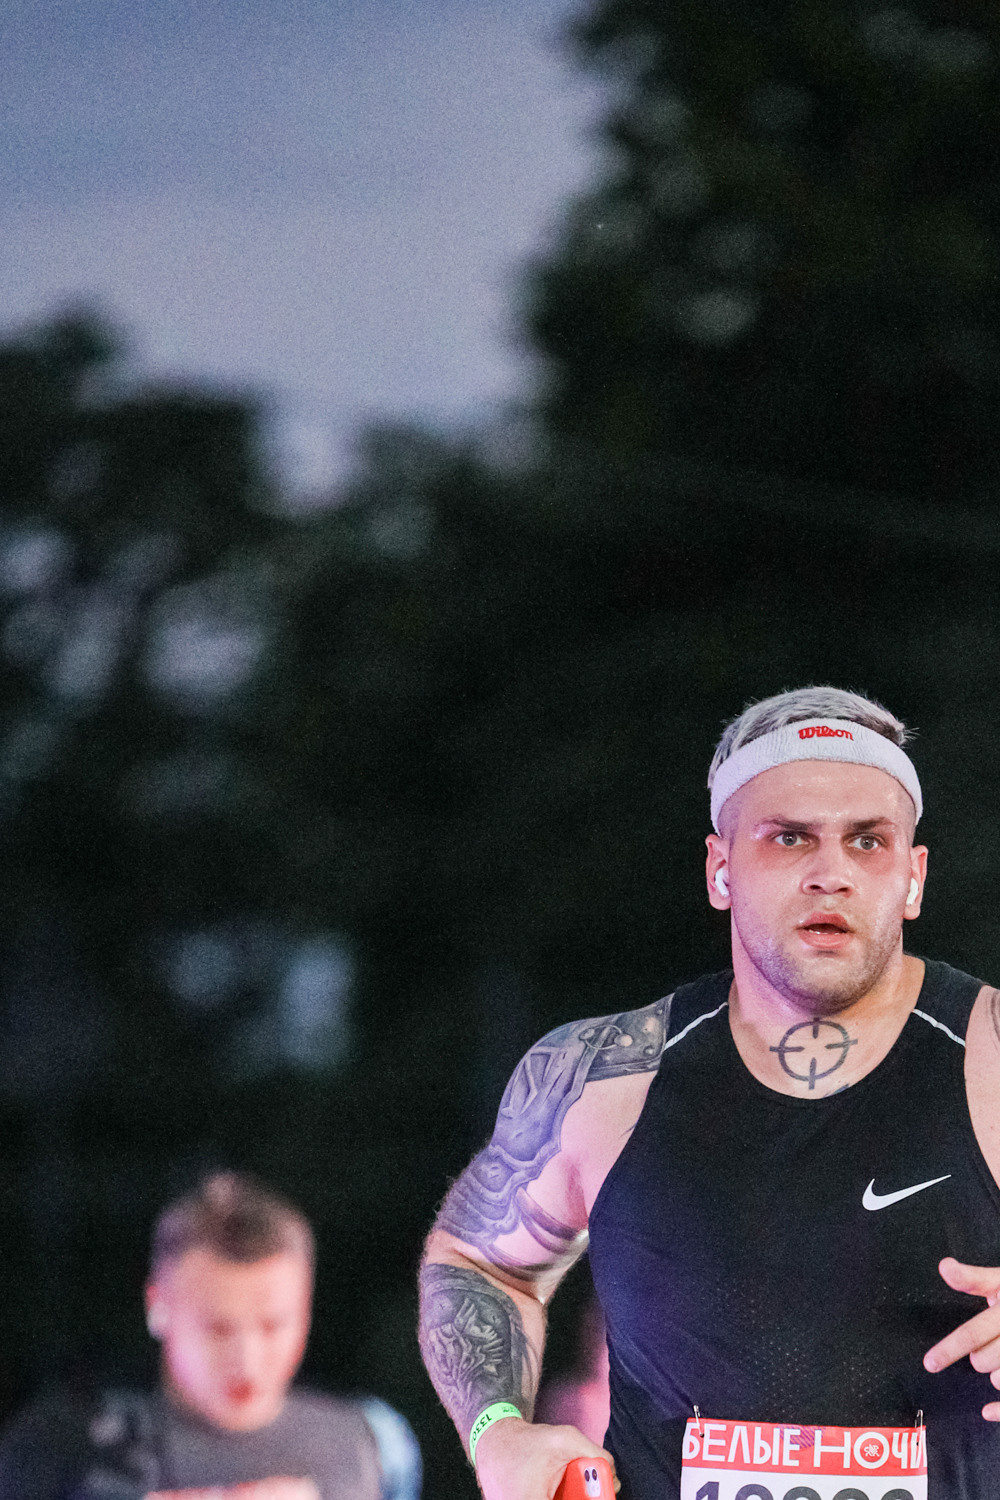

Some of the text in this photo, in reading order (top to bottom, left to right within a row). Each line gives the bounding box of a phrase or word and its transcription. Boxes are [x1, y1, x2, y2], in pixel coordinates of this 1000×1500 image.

[798, 726, 854, 741] Wilson
[471, 1413, 493, 1449] 1330
[682, 1422, 928, 1469] БЕЛЫЕ НОЧИ
